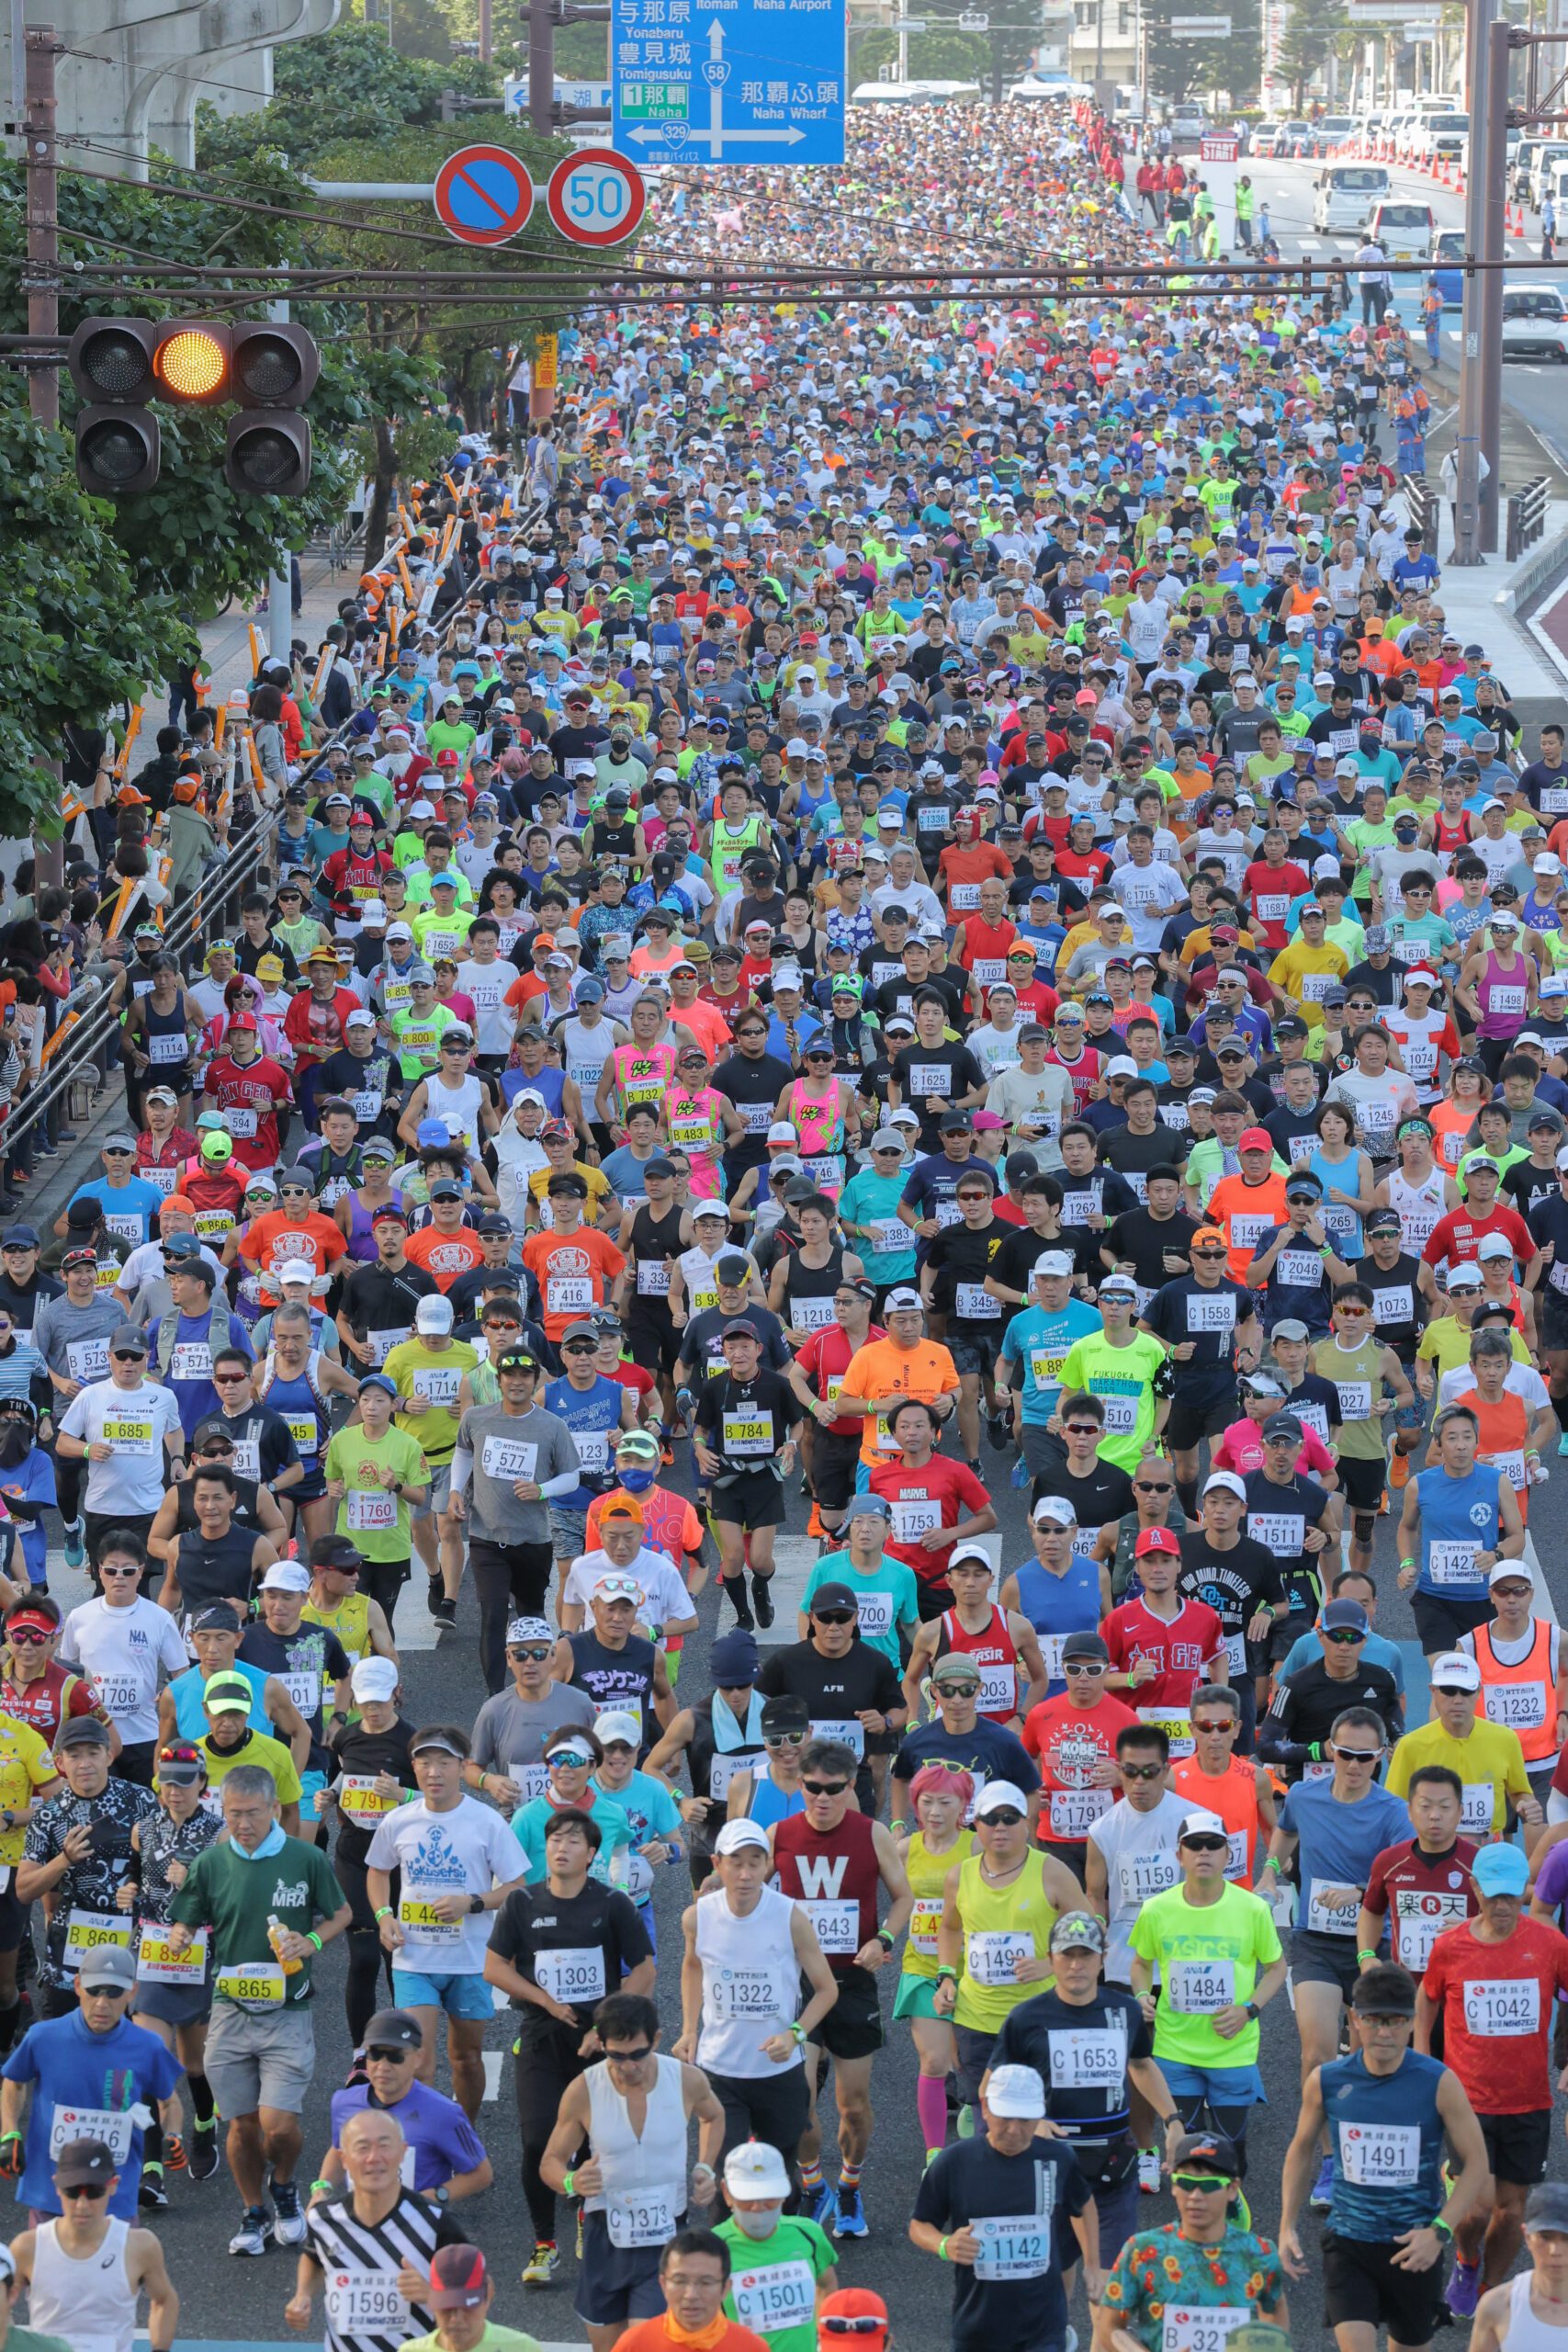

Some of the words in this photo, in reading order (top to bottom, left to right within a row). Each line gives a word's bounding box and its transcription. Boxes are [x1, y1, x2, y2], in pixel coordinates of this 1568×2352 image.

[618, 1, 691, 23] 与那原
[626, 27, 683, 40] Yonabaru
[618, 42, 691, 64] 豊見城
[619, 68, 692, 82] Tomigusuku
[707, 66, 726, 80] 58
[644, 85, 686, 106] 那覇
[741, 82, 840, 105] 那覇ふ頭
[649, 107, 682, 118] Naha
[753, 107, 784, 119] Naha
[791, 107, 828, 119] Wharf
[665, 127, 685, 139] 329
[1202, 142, 1235, 161] START
[571, 176, 623, 218] 50
[927, 815, 946, 823] 1336
[1134, 889, 1155, 899] 1715
[1267, 902, 1286, 913] 1687
[433, 940, 455, 951] 1652
[981, 968, 1002, 978] 1107
[1499, 993, 1521, 1005] 1498
[412, 1033, 429, 1043] 800
[151, 1046, 156, 1054] C
[160, 1044, 183, 1054] 1114
[1410, 1054, 1433, 1064] 1074
[580, 1070, 604, 1080] 1022
[911, 1076, 918, 1085] C
[921, 1074, 945, 1085] 1625
[639, 1089, 659, 1101] 732
[355, 1102, 374, 1113] 654
[232, 1117, 250, 1128] 594
[1359, 1113, 1364, 1122] C
[1369, 1111, 1393, 1122] 1245
[683, 1128, 704, 1140] 483
[207, 1219, 228, 1232] 866
[1325, 1216, 1350, 1228] 1265
[110, 1225, 138, 1238] 1045
[1408, 1223, 1433, 1236] 1446
[1289, 1261, 1318, 1275] 2046
[650, 1272, 671, 1283] 334
[548, 1291, 555, 1301] B
[562, 1290, 582, 1302] 416
[957, 1295, 964, 1306] B
[971, 1295, 992, 1307] 345
[1379, 1298, 1407, 1312] 1073
[793, 1311, 799, 1322] C
[803, 1309, 832, 1322] 1218
[1190, 1308, 1196, 1319] C
[1201, 1307, 1230, 1319] 1558
[69, 1356, 77, 1368] B
[85, 1350, 107, 1366] 573
[173, 1356, 181, 1368] B
[188, 1353, 210, 1367] 571
[1033, 1362, 1043, 1374] B
[1093, 1370, 1134, 1380] FUKUOKA
[415, 1383, 423, 1395] C
[428, 1382, 457, 1394] 1714
[1093, 1379, 1139, 1389] MARATHON
[9, 1400, 28, 1412] THY
[1107, 1408, 1132, 1423] 510
[103, 1423, 112, 1438] B
[118, 1424, 143, 1438] 685
[726, 1425, 732, 1438] B
[739, 1424, 762, 1437] 784
[483, 1450, 491, 1463] B
[500, 1453, 525, 1468] 577
[899, 1487, 928, 1500] MARVEL
[348, 1503, 355, 1516] C
[359, 1504, 391, 1518] 1760
[900, 1515, 934, 1530] 1753
[1250, 1528, 1257, 1542] C
[1263, 1528, 1294, 1544] 1511
[1432, 1555, 1438, 1569] C
[1444, 1555, 1475, 1569] 1427
[1181, 1573, 1198, 1592] OUR
[101, 1688, 137, 1704] 1706
[1486, 1701, 1496, 1715] C
[1502, 1697, 1540, 1715] 1232
[1060, 1741, 1097, 1757] KOBE
[343, 1792, 352, 1808] B
[1052, 1807, 1061, 1824] C
[1067, 1805, 1103, 1824] 1791
[795, 1855, 849, 1899] W
[1121, 1868, 1129, 1885] C
[1134, 1865, 1174, 1886] 1159
[273, 1893, 306, 1907] MRA
[402, 1904, 411, 1920] B
[812, 1917, 850, 1936] 1643
[69, 1926, 80, 1944] B
[141, 1940, 152, 1959] B
[969, 1951, 979, 1969] C
[537, 1967, 547, 1986] C
[556, 1966, 597, 1984] 1303
[219, 1978, 230, 1996] B
[238, 1980, 271, 1998] 865
[713, 1983, 722, 2001] C
[729, 1984, 773, 2003] 1322
[1170, 1977, 1178, 1995] C
[1183, 1977, 1226, 1996] 1484
[1467, 2000, 1478, 2019] C
[1485, 1997, 1531, 2018] 1042
[1053, 2049, 1065, 2070] C
[1072, 2048, 1118, 2069] 1653
[53, 2124, 65, 2144] C
[1343, 2143, 1353, 2164] C
[1359, 2144, 1406, 2167] 1491
[610, 2208, 620, 2228] C
[628, 2205, 668, 2228] 1373
[977, 2239, 986, 2260] C
[993, 2236, 1042, 2260] 1142
[330, 2291, 340, 2313] C
[348, 2290, 398, 2313] 1596
[738, 2292, 750, 2314] C
[758, 2282, 805, 2312] 1501
[1166, 2326, 1179, 2349] B
